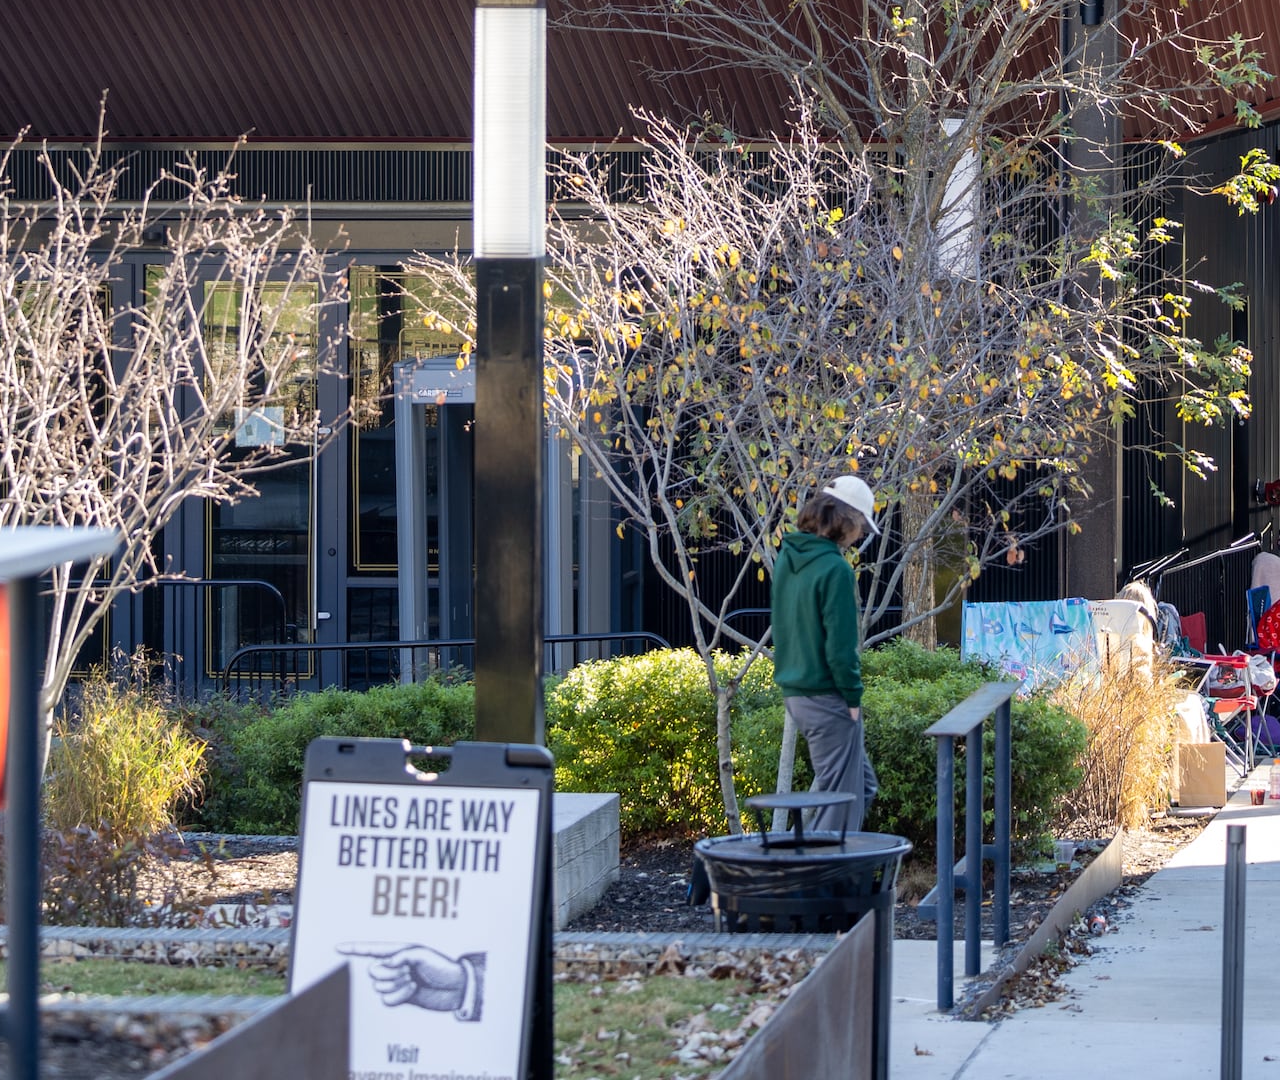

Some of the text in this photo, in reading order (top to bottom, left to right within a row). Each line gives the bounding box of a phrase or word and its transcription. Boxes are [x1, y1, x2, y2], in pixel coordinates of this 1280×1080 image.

[330, 794, 515, 834] LINES ARE WAY
[337, 835, 501, 872] BETTER WITH
[371, 875, 461, 919] BEER!
[387, 1043, 420, 1064] Visit
